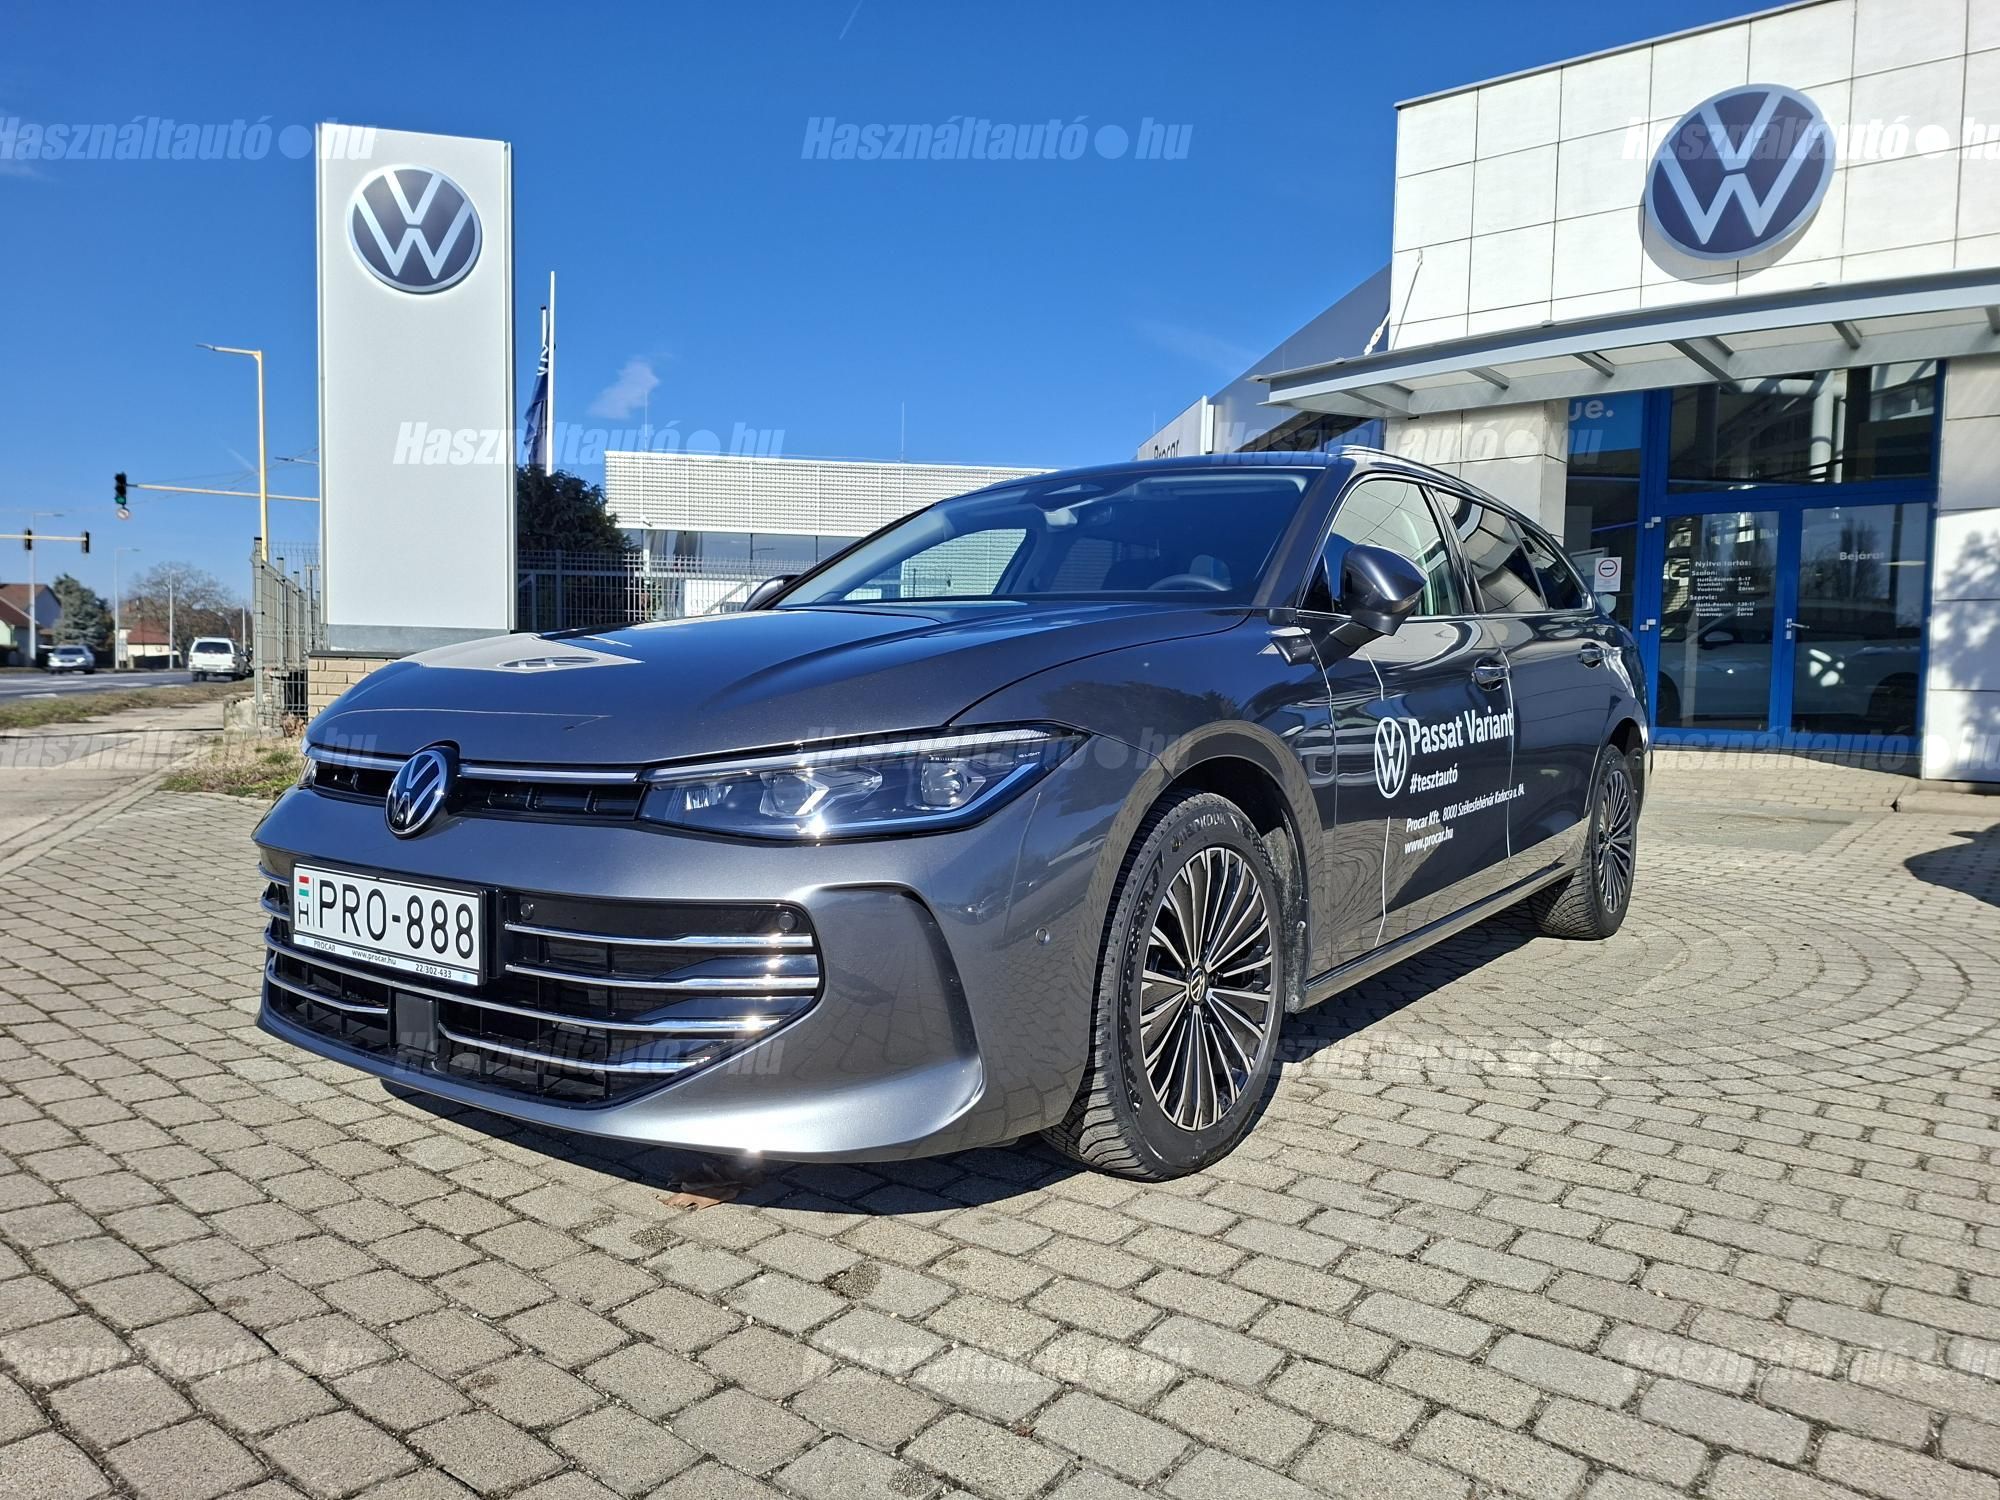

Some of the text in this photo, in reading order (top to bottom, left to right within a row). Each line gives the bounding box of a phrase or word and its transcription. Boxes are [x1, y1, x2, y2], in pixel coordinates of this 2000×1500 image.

[1408, 706, 1514, 756] Passat Variant
[1409, 763, 1458, 794] #tesztautó
[1405, 818, 1428, 833] Procar
[1428, 809, 1440, 826] Kft.
[1442, 803, 1458, 822] 8000
[1404, 826, 1454, 854] www.procar.hu
[298, 879, 474, 960] H PRO-888
[313, 940, 336, 952] PROCAR
[352, 949, 397, 966] www.procar.hu
